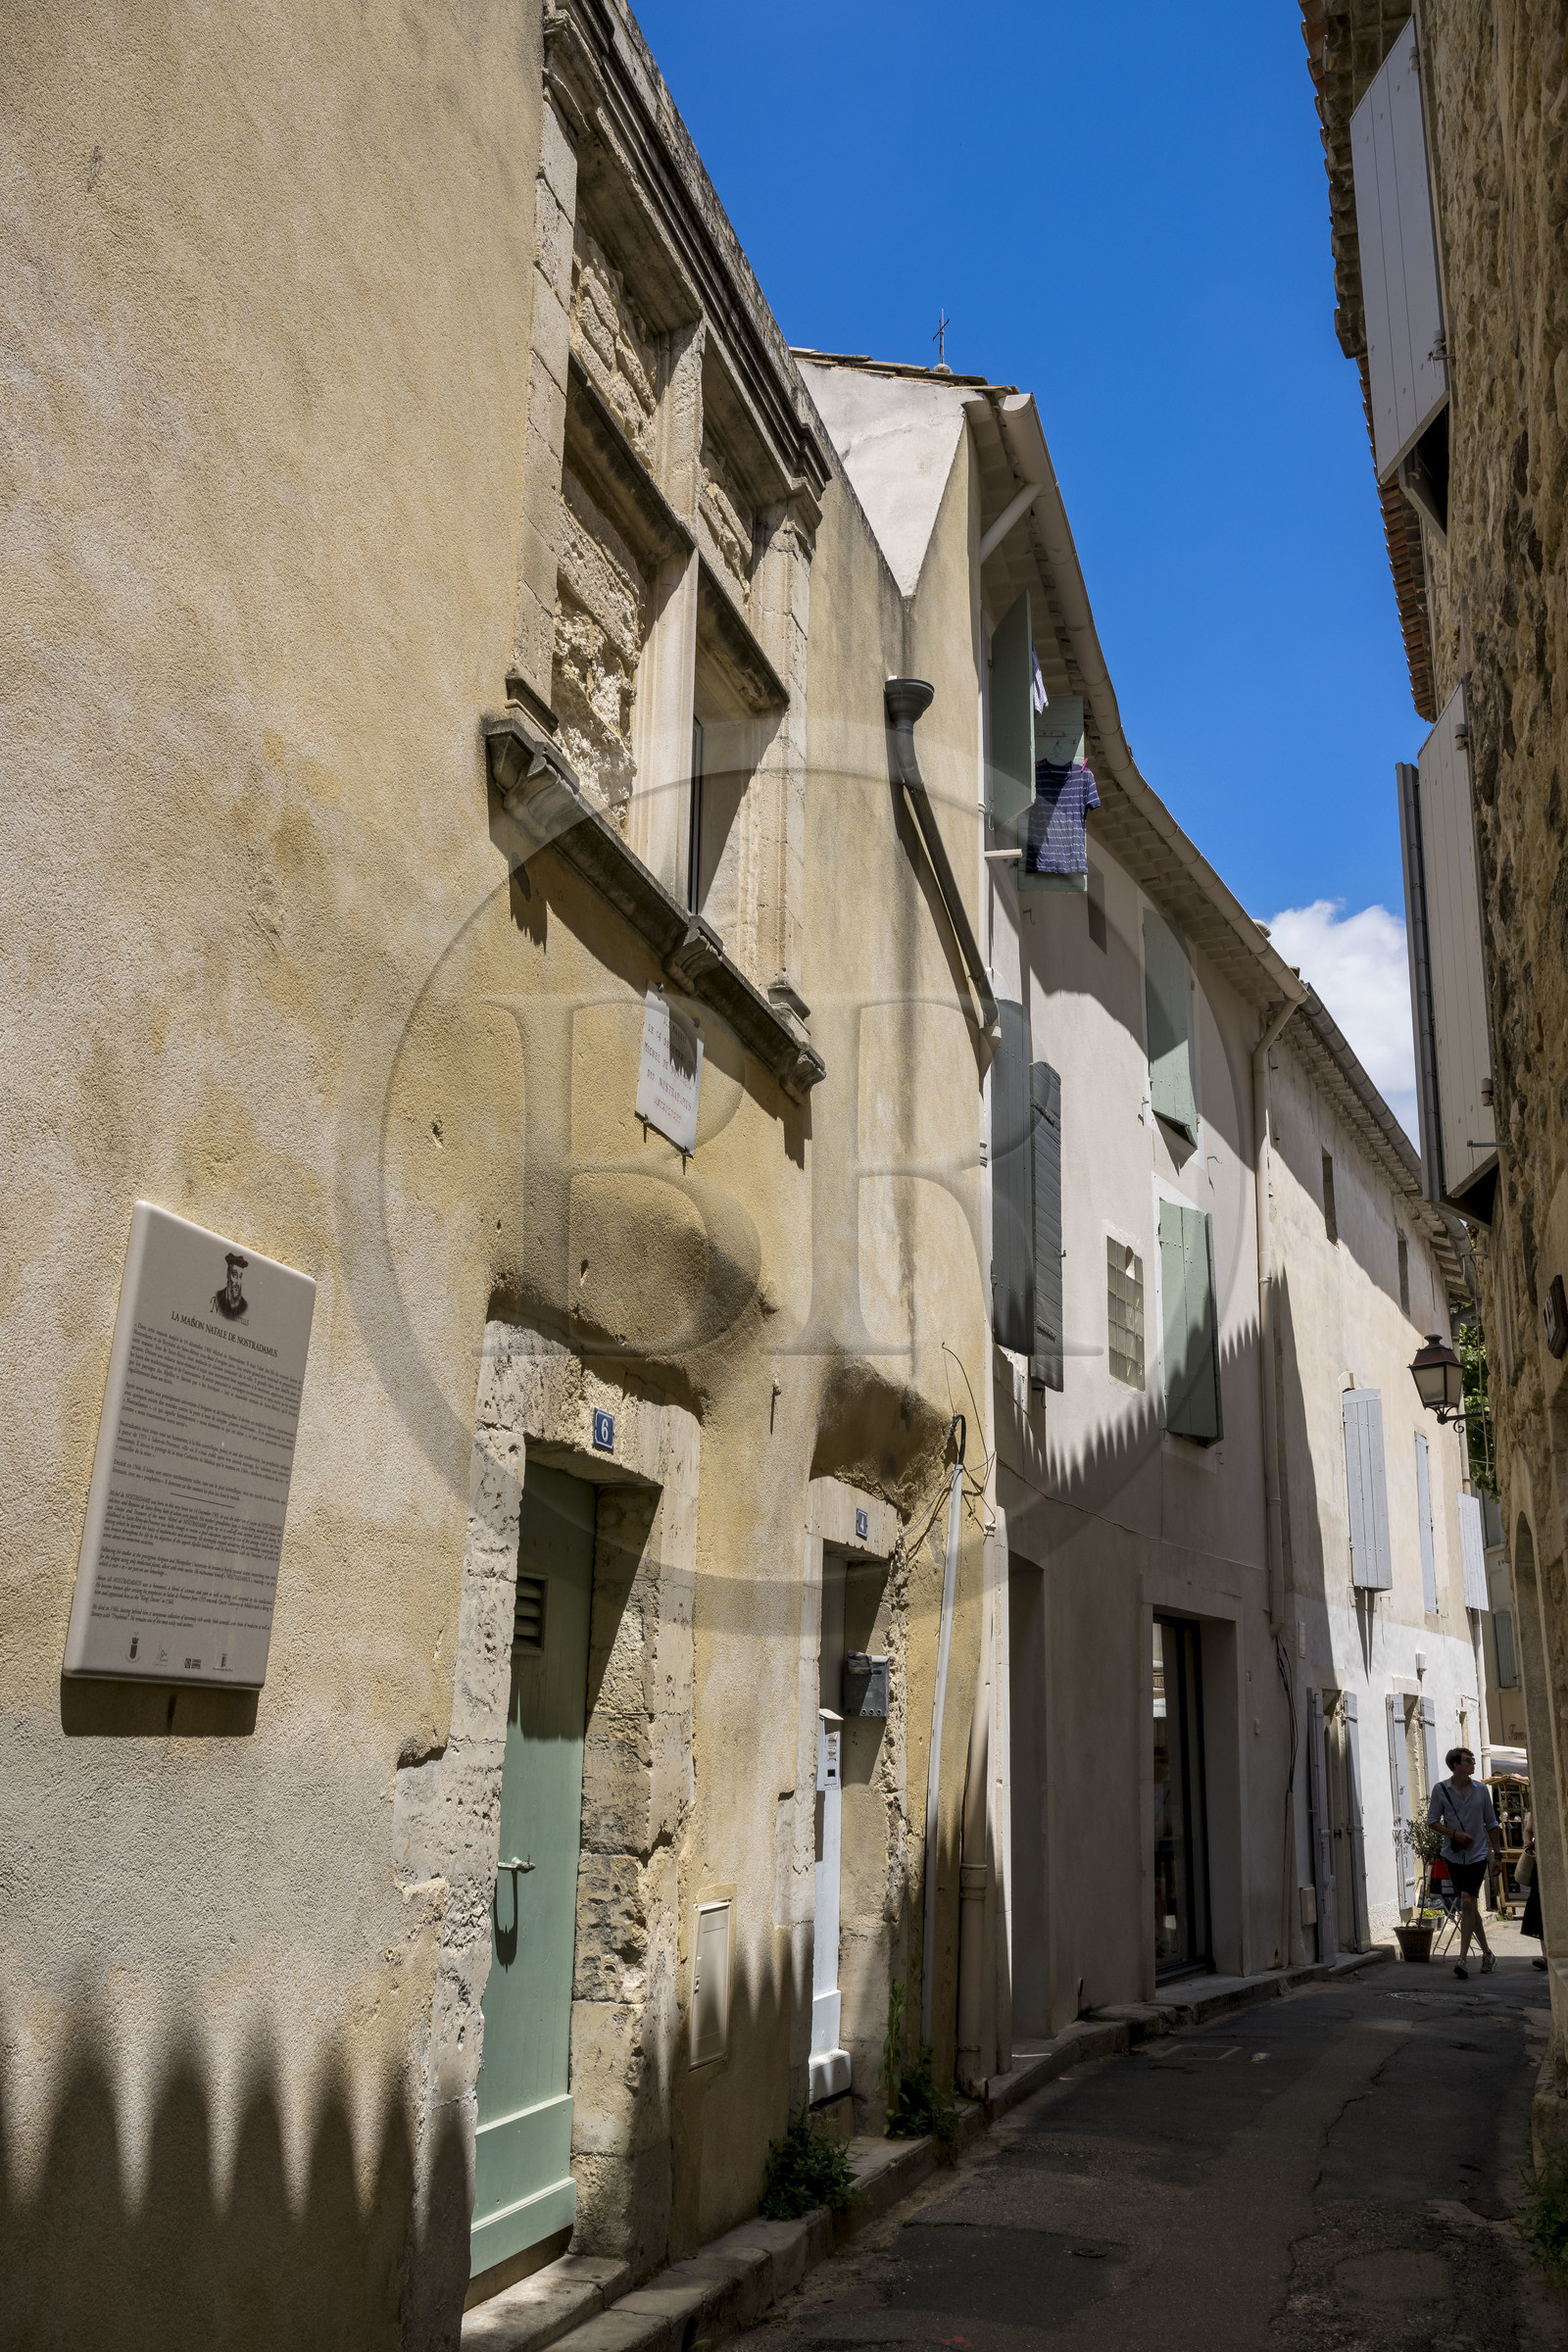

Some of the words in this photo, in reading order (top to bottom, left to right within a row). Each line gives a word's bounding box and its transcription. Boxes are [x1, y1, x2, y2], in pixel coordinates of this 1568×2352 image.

[648, 1023, 654, 1035] LE
[656, 1030, 662, 1042] 14
[644, 1042, 661, 1063] MICHEL
[662, 1058, 668, 1070] DE
[659, 1077, 692, 1112] NOSTRADAMUS
[172, 1311, 179, 1322] LA
[180, 1314, 204, 1331] MAISON
[206, 1324, 227, 1340] NATALE
[228, 1333, 236, 1343] DE
[237, 1335, 278, 1358] NOSTRADAMUS
[602, 1418, 609, 1442] 6
[859, 1515, 865, 1533] 4
